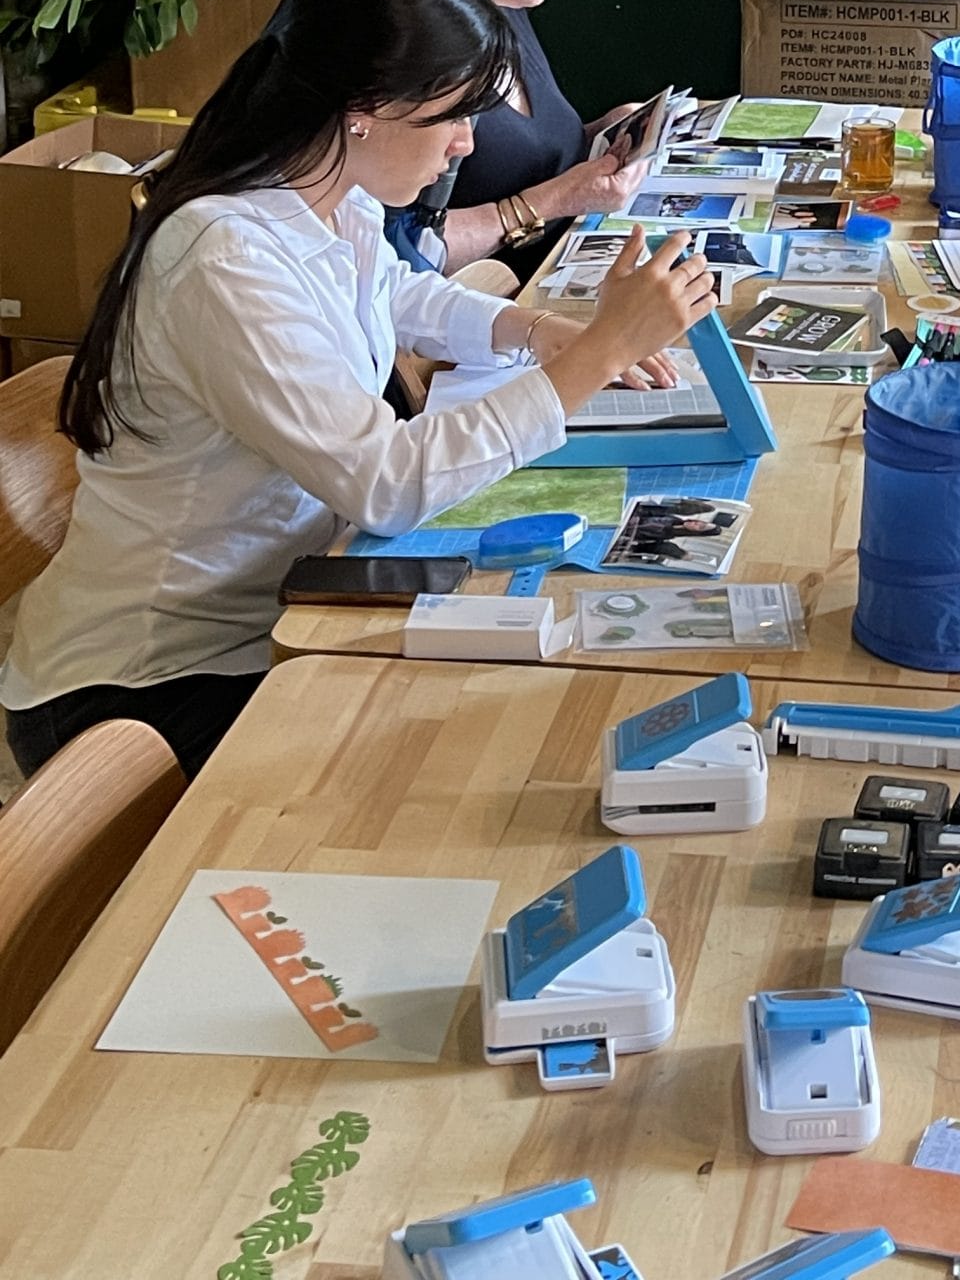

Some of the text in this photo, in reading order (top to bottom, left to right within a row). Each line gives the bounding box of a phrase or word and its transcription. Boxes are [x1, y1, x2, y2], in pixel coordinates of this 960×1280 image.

[785, 4, 950, 24] ITEM#: HCMP001-1-BLK
[812, 30, 867, 41] HC24008
[781, 43, 916, 57] ITEM#: HCMP001-1-BLK
[781, 57, 832, 68] FACTORY
[781, 71, 836, 82] PRODUCT
[840, 72, 876, 84] NAME:
[879, 75, 907, 86] Metal
[781, 85, 929, 100] CARTON DIMENSIONS: 40.3
